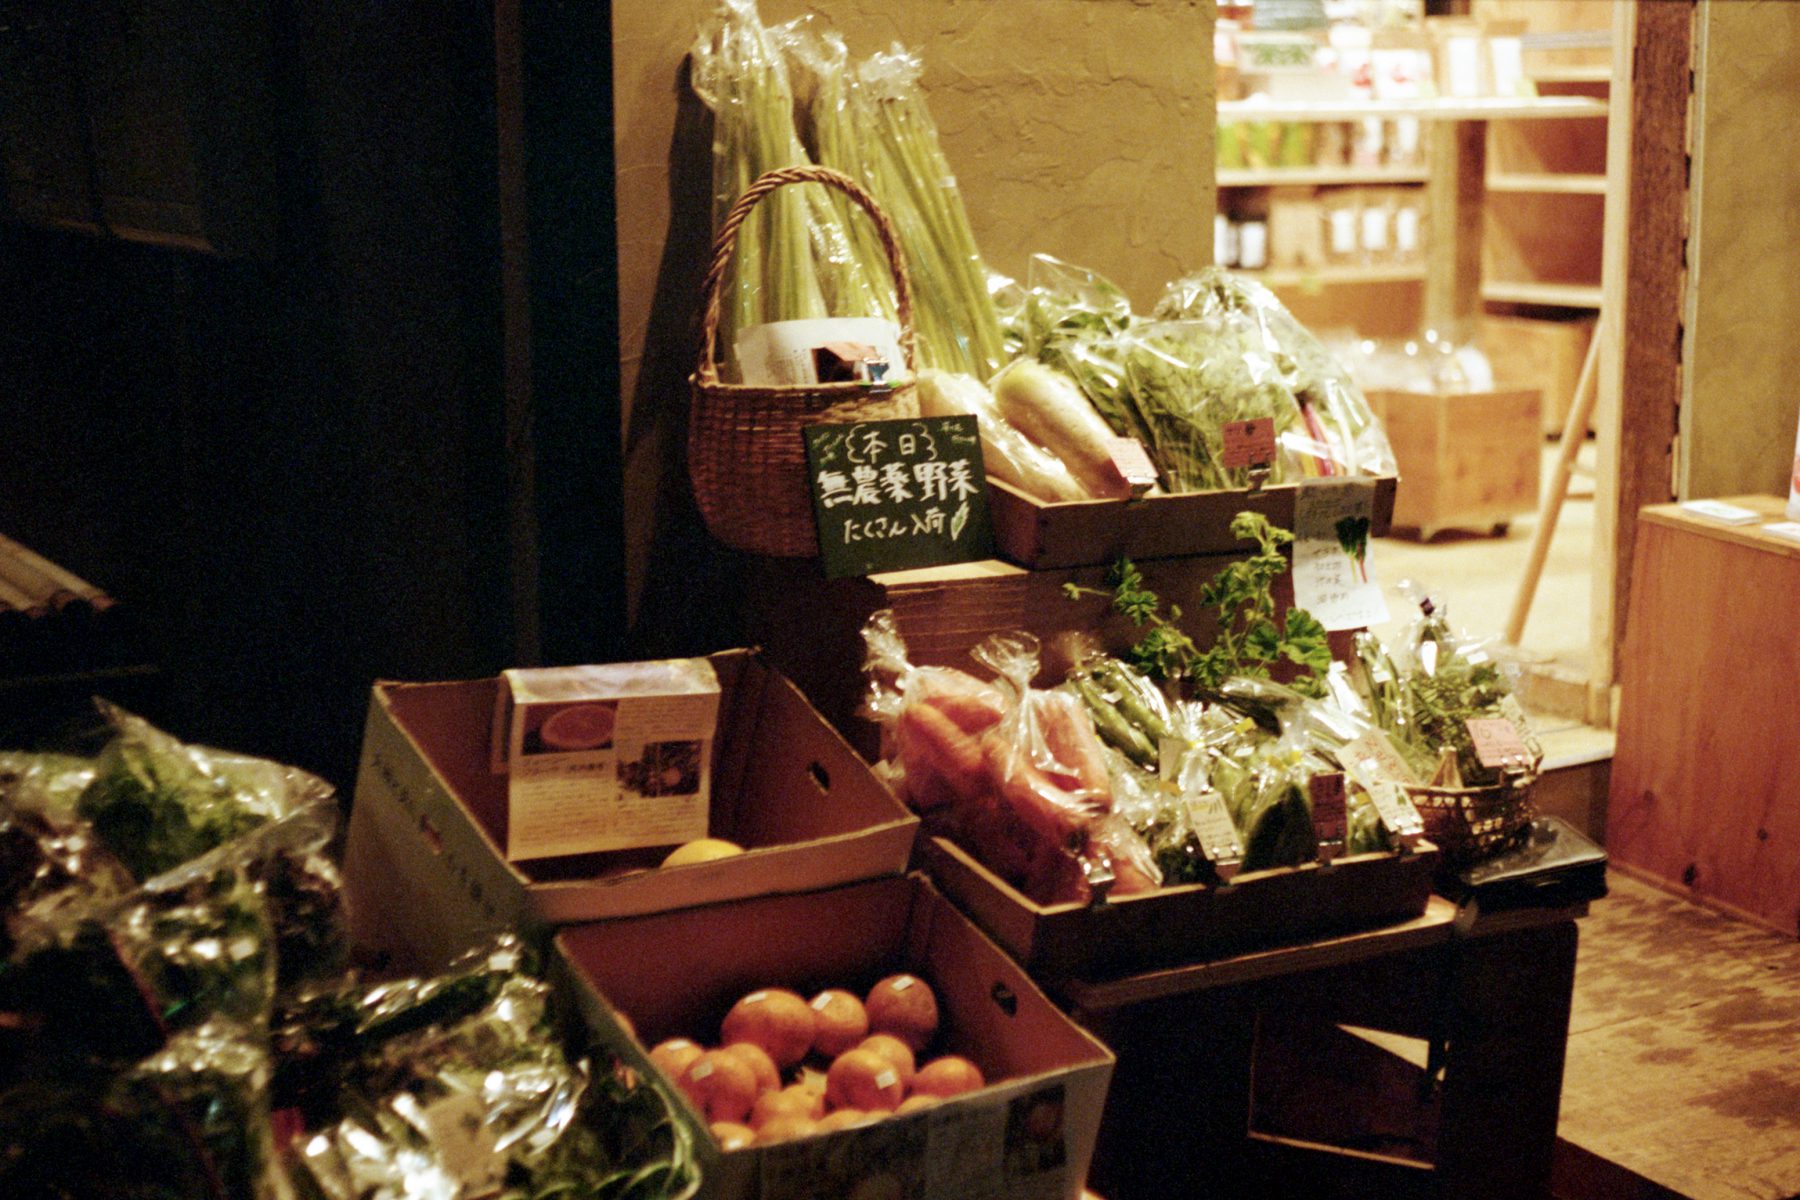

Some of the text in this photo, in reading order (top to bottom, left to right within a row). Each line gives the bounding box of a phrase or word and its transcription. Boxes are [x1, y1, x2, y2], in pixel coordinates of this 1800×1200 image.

[863, 431, 916, 464] 本日
[817, 458, 979, 508] 無農薬野菜
[843, 506, 947, 544] たくさん入荷
